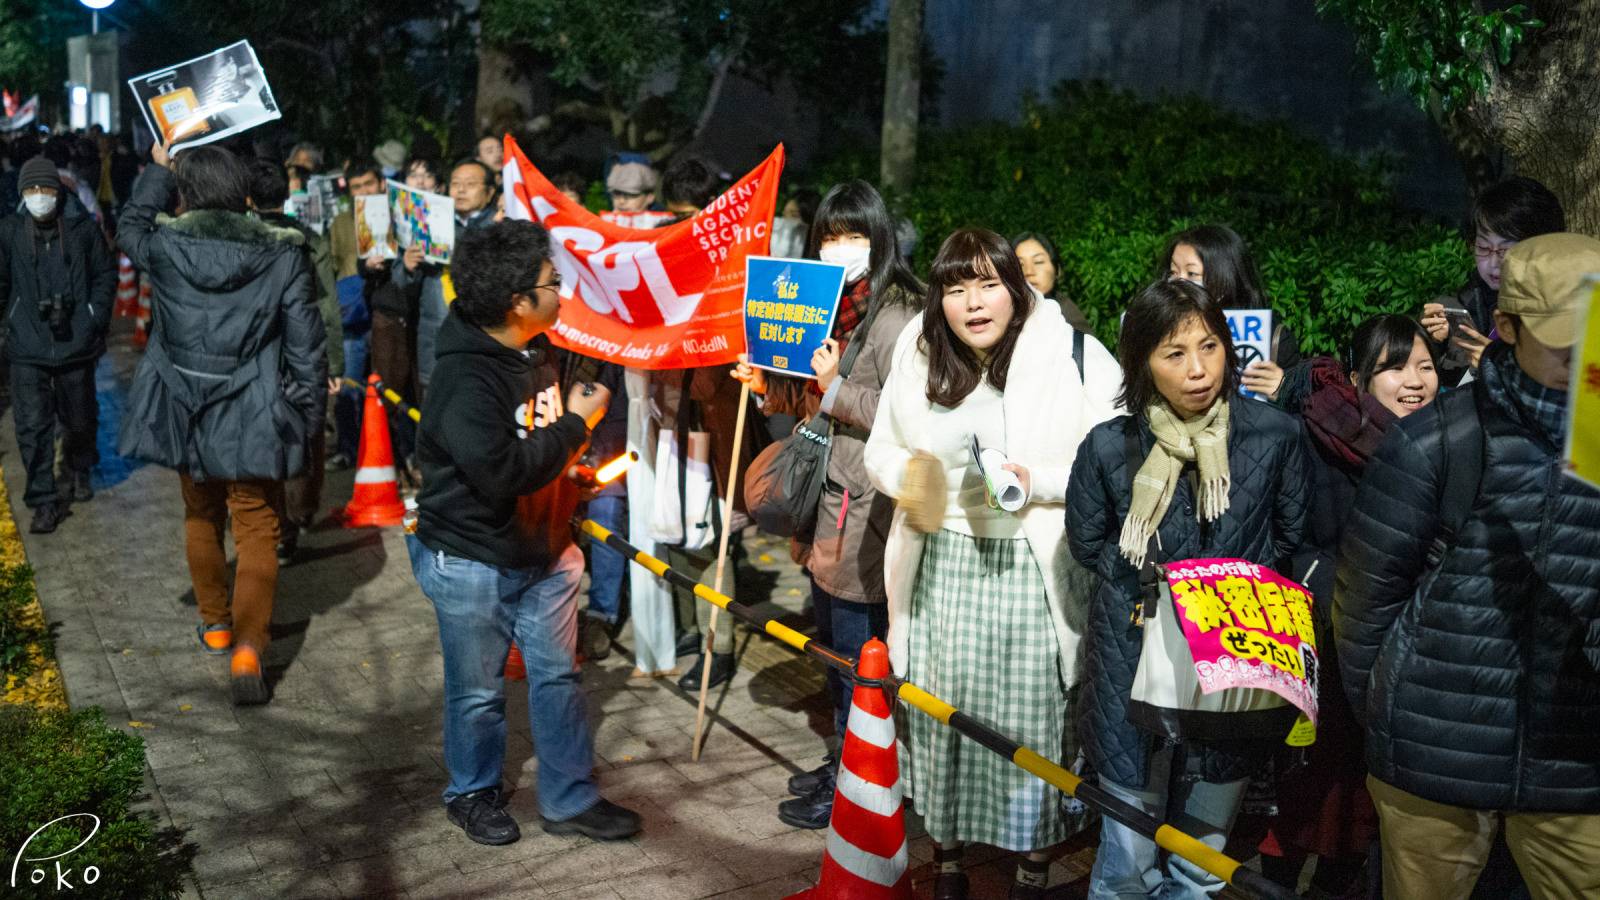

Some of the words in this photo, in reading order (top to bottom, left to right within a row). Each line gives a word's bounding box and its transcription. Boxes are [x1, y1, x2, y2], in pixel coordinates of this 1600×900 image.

[777, 281, 799, 299] 私は
[747, 299, 829, 325] 特定秘密保護法に
[759, 322, 806, 345] 反対します
[1226, 315, 1263, 341] AR
[1171, 575, 1316, 647] 秘密保護
[1226, 632, 1303, 671] ぜったい
